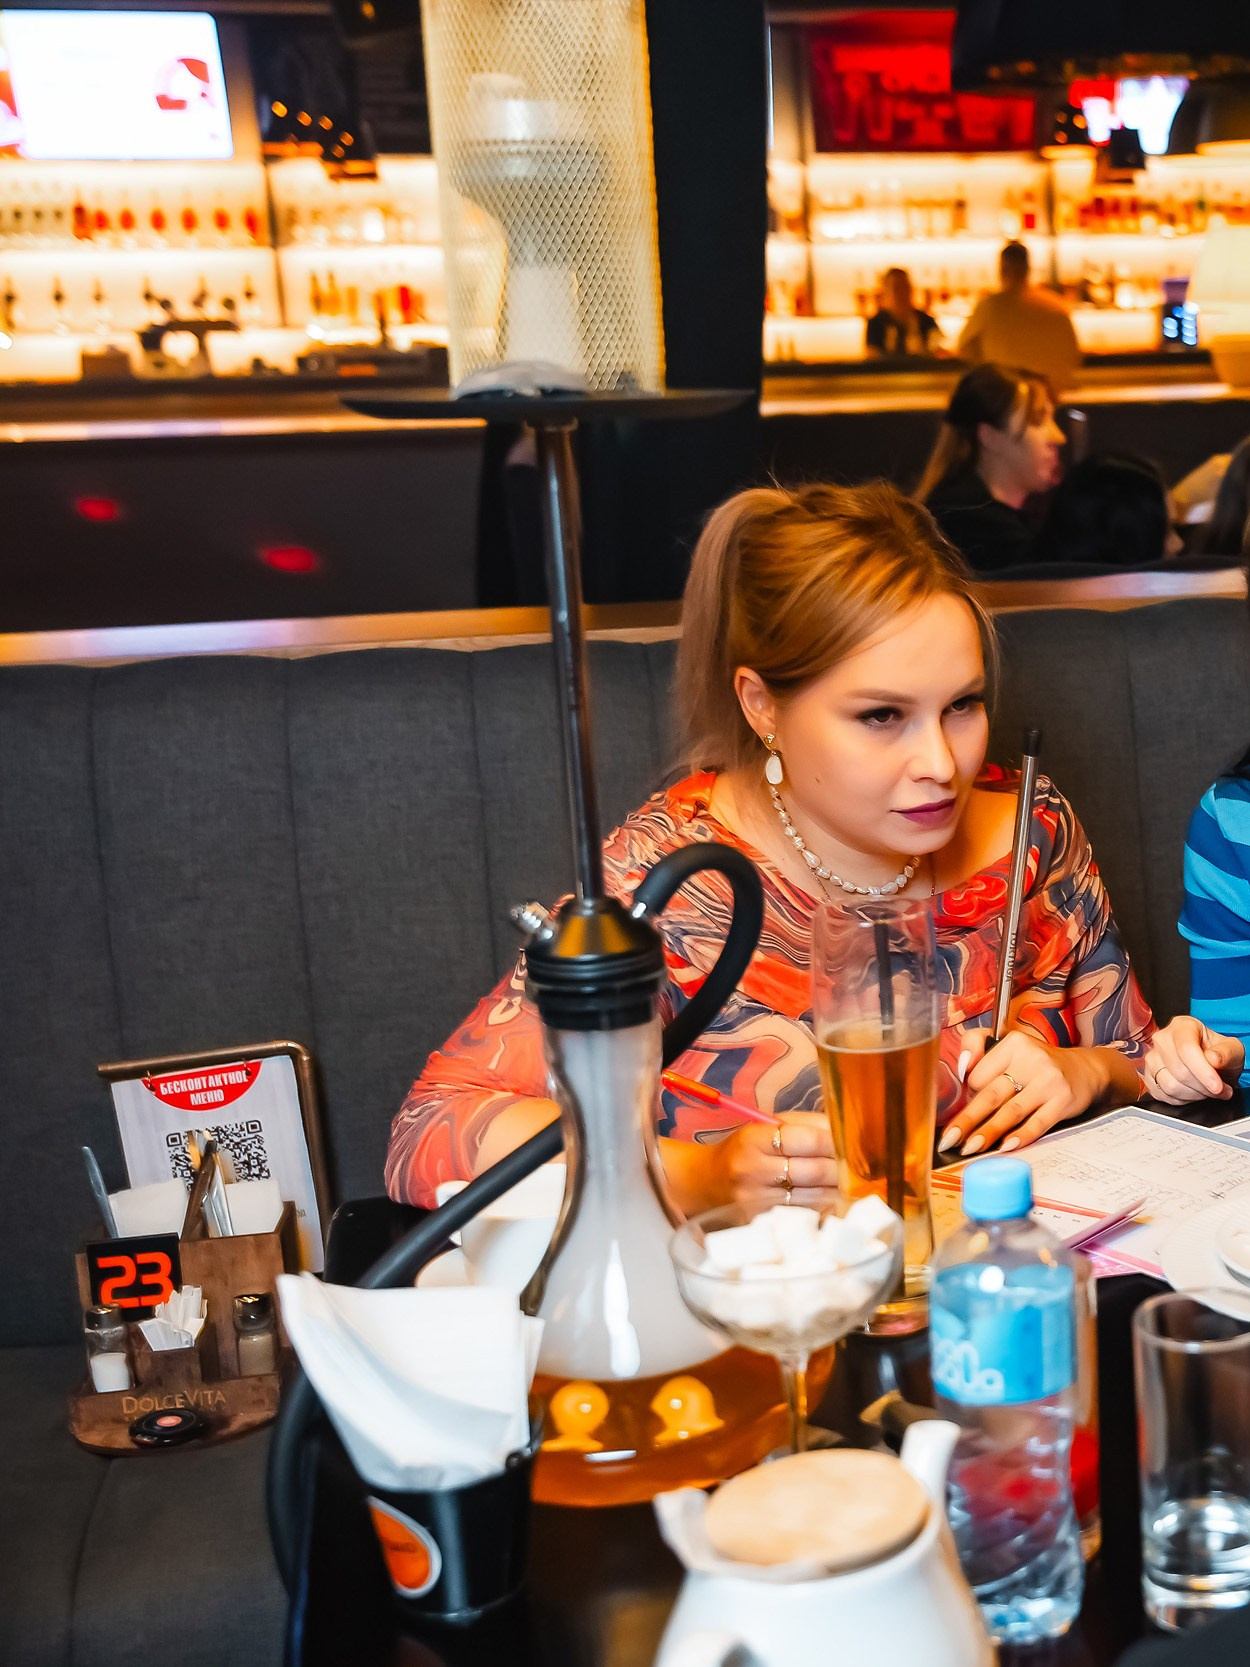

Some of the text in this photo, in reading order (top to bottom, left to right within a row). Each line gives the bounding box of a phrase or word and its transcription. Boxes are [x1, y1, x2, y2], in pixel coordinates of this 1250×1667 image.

[160, 1070, 248, 1095] БЕСКОНТАКТНОЕ
[190, 1089, 225, 1106] МЕНЮ
[97, 1251, 174, 1309] 23
